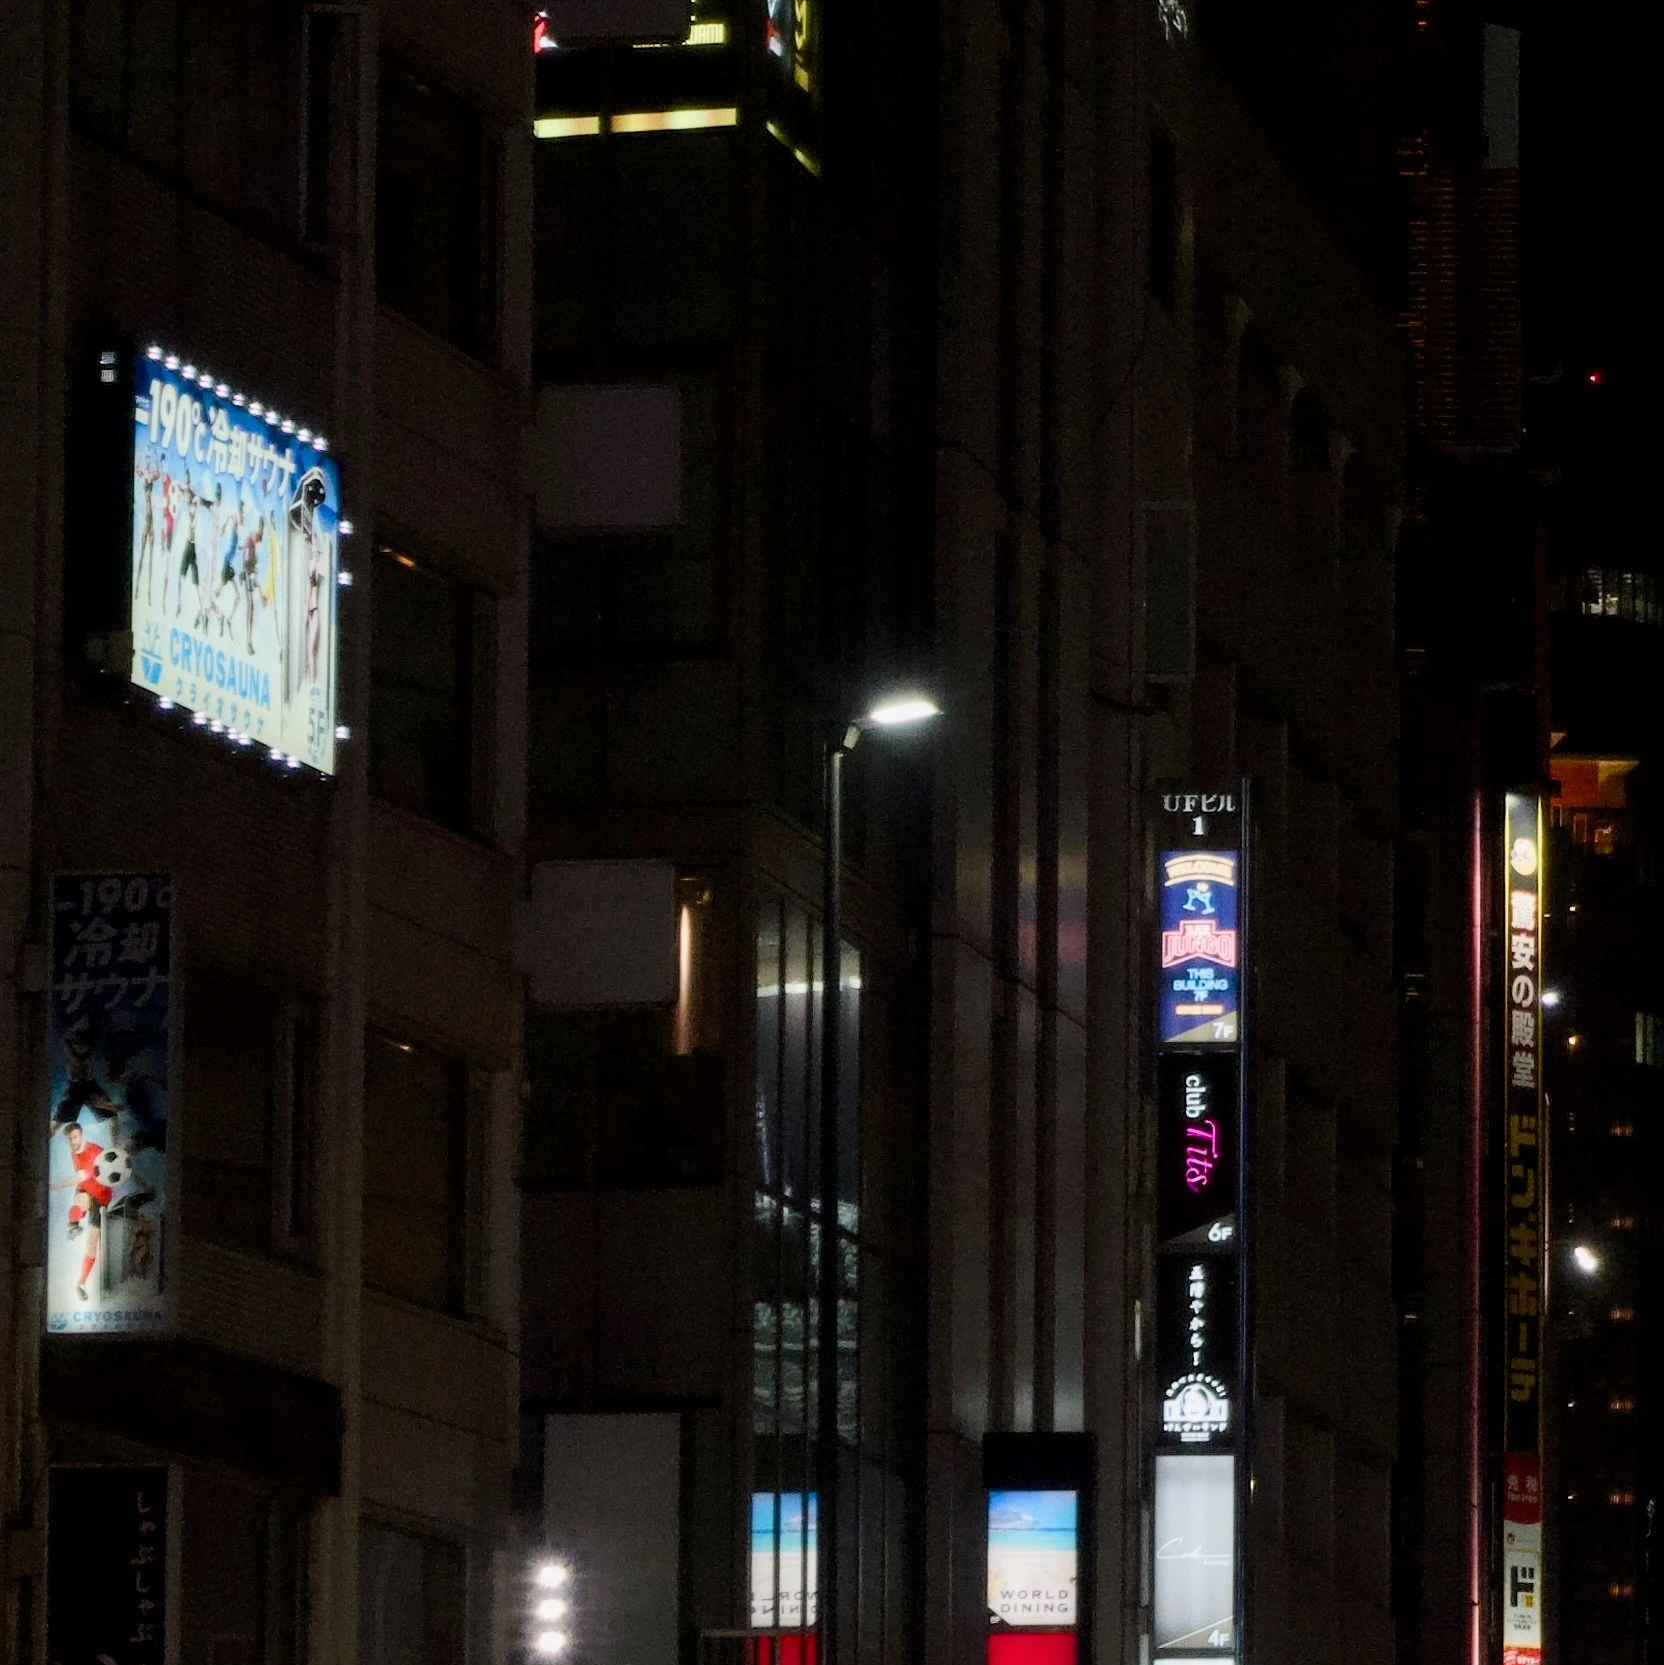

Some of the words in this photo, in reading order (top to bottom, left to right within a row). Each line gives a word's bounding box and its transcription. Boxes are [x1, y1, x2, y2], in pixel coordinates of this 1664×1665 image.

[169, 628, 271, 711] CRYOSAUNA
[1162, 794, 1235, 813] UFビル
[64, 917, 160, 968] 冷却
[54, 965, 169, 1014] サウナ
[1173, 979, 1229, 991] BUILDING
[1213, 1022, 1235, 1039] 7F
[1185, 1075, 1206, 1118] club
[1207, 1222, 1233, 1242] 6F
[1000, 1589, 1069, 1600] WORLD
[1000, 1603, 1069, 1613] DINING
[1207, 1629, 1230, 1647] 4F
